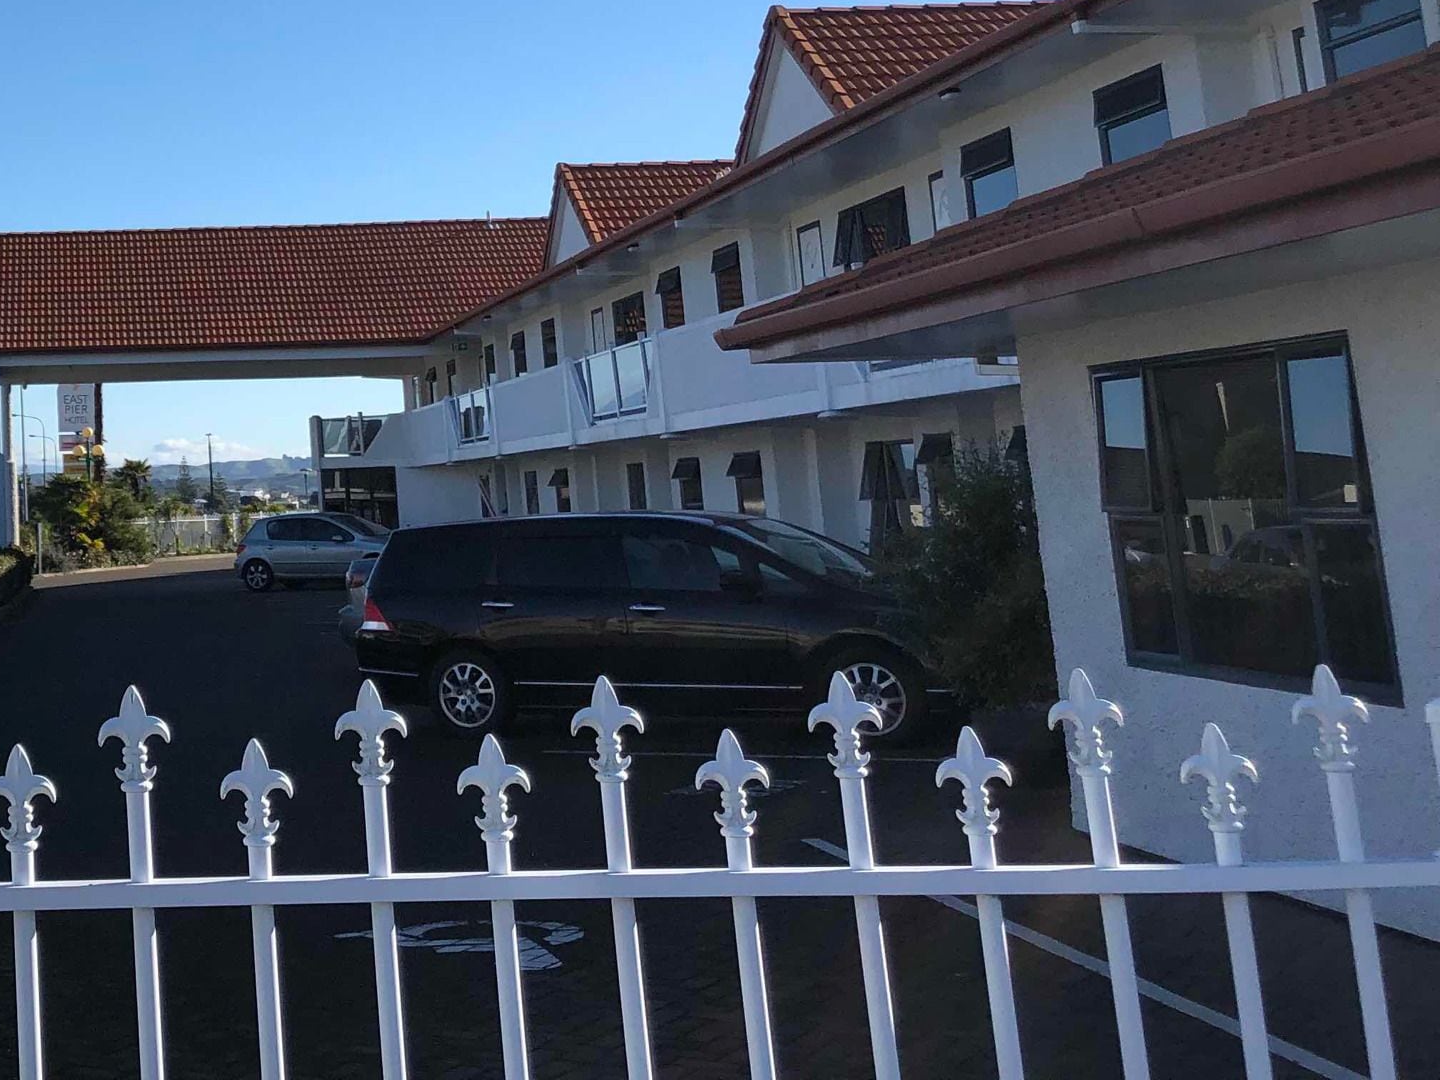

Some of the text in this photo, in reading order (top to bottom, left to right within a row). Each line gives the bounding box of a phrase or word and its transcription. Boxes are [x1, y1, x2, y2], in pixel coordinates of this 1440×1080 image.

[63, 394, 89, 405] EAST
[64, 405, 88, 415] PIER
[64, 416, 89, 425] HOTEL
